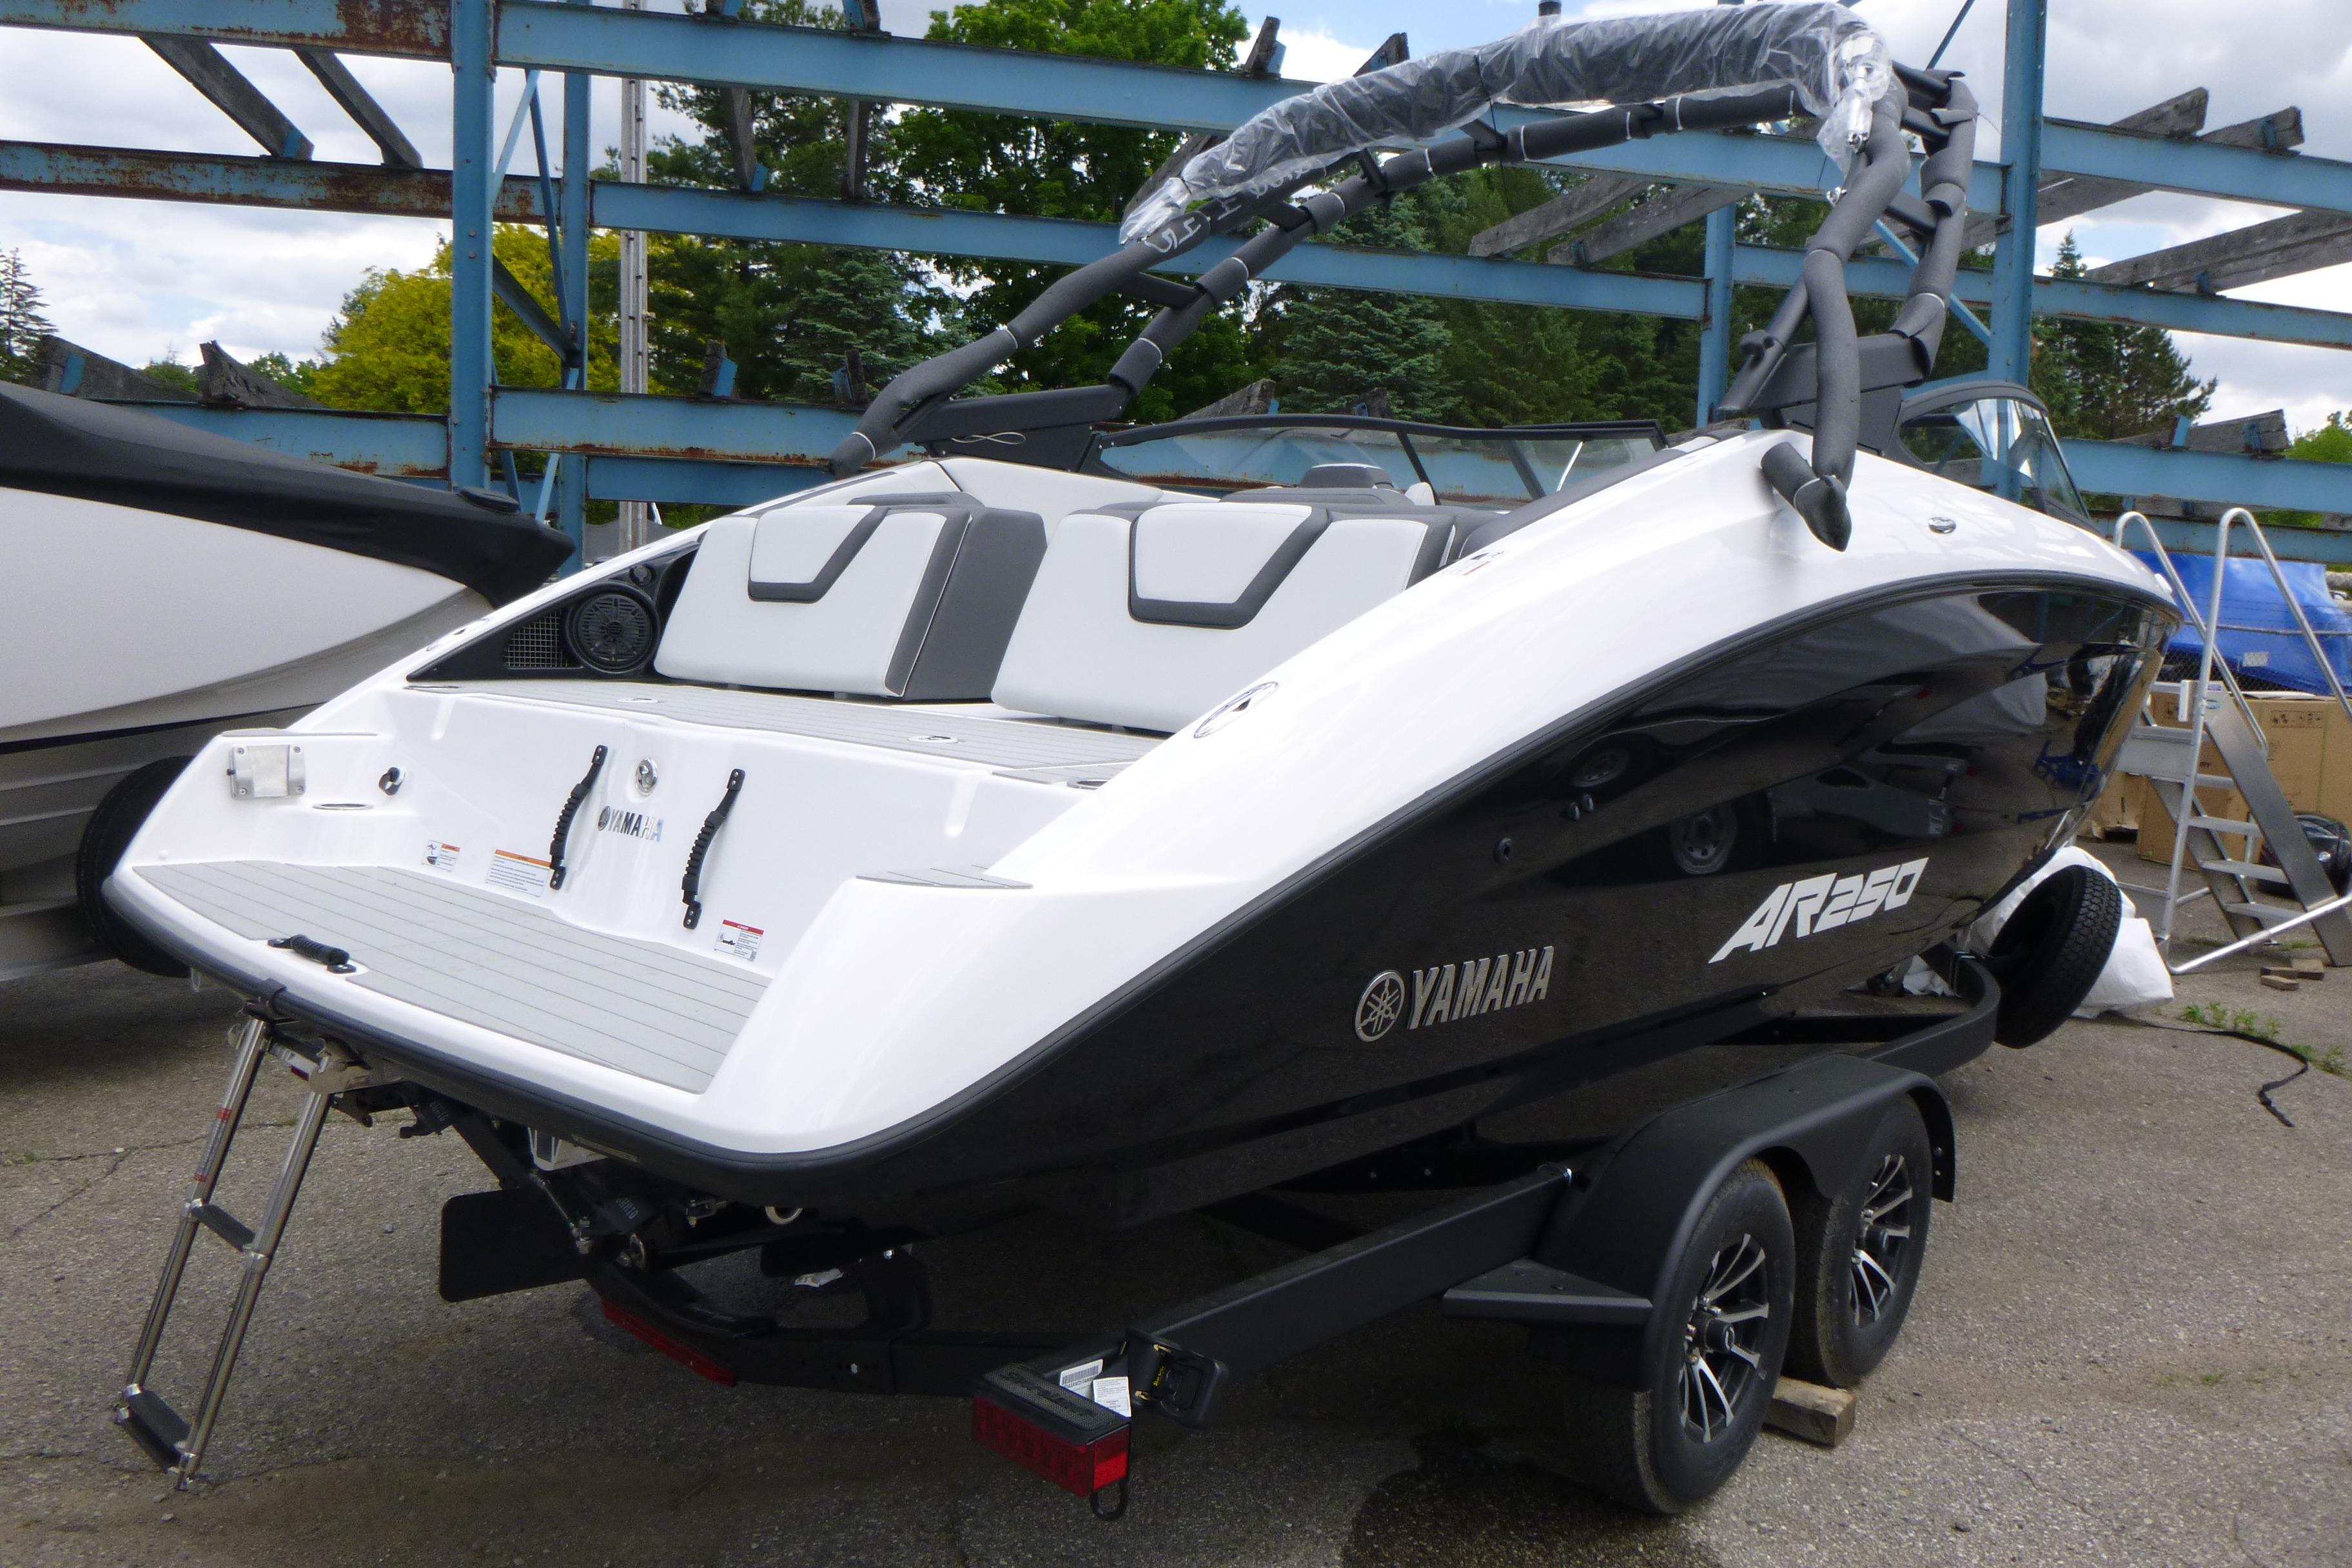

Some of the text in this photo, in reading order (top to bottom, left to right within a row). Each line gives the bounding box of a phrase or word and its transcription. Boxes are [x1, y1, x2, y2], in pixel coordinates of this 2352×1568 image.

[608, 808, 663, 842] YAMAHA
[1708, 857, 1929, 964] AR250
[1407, 946, 1554, 1030] YAMAHA
